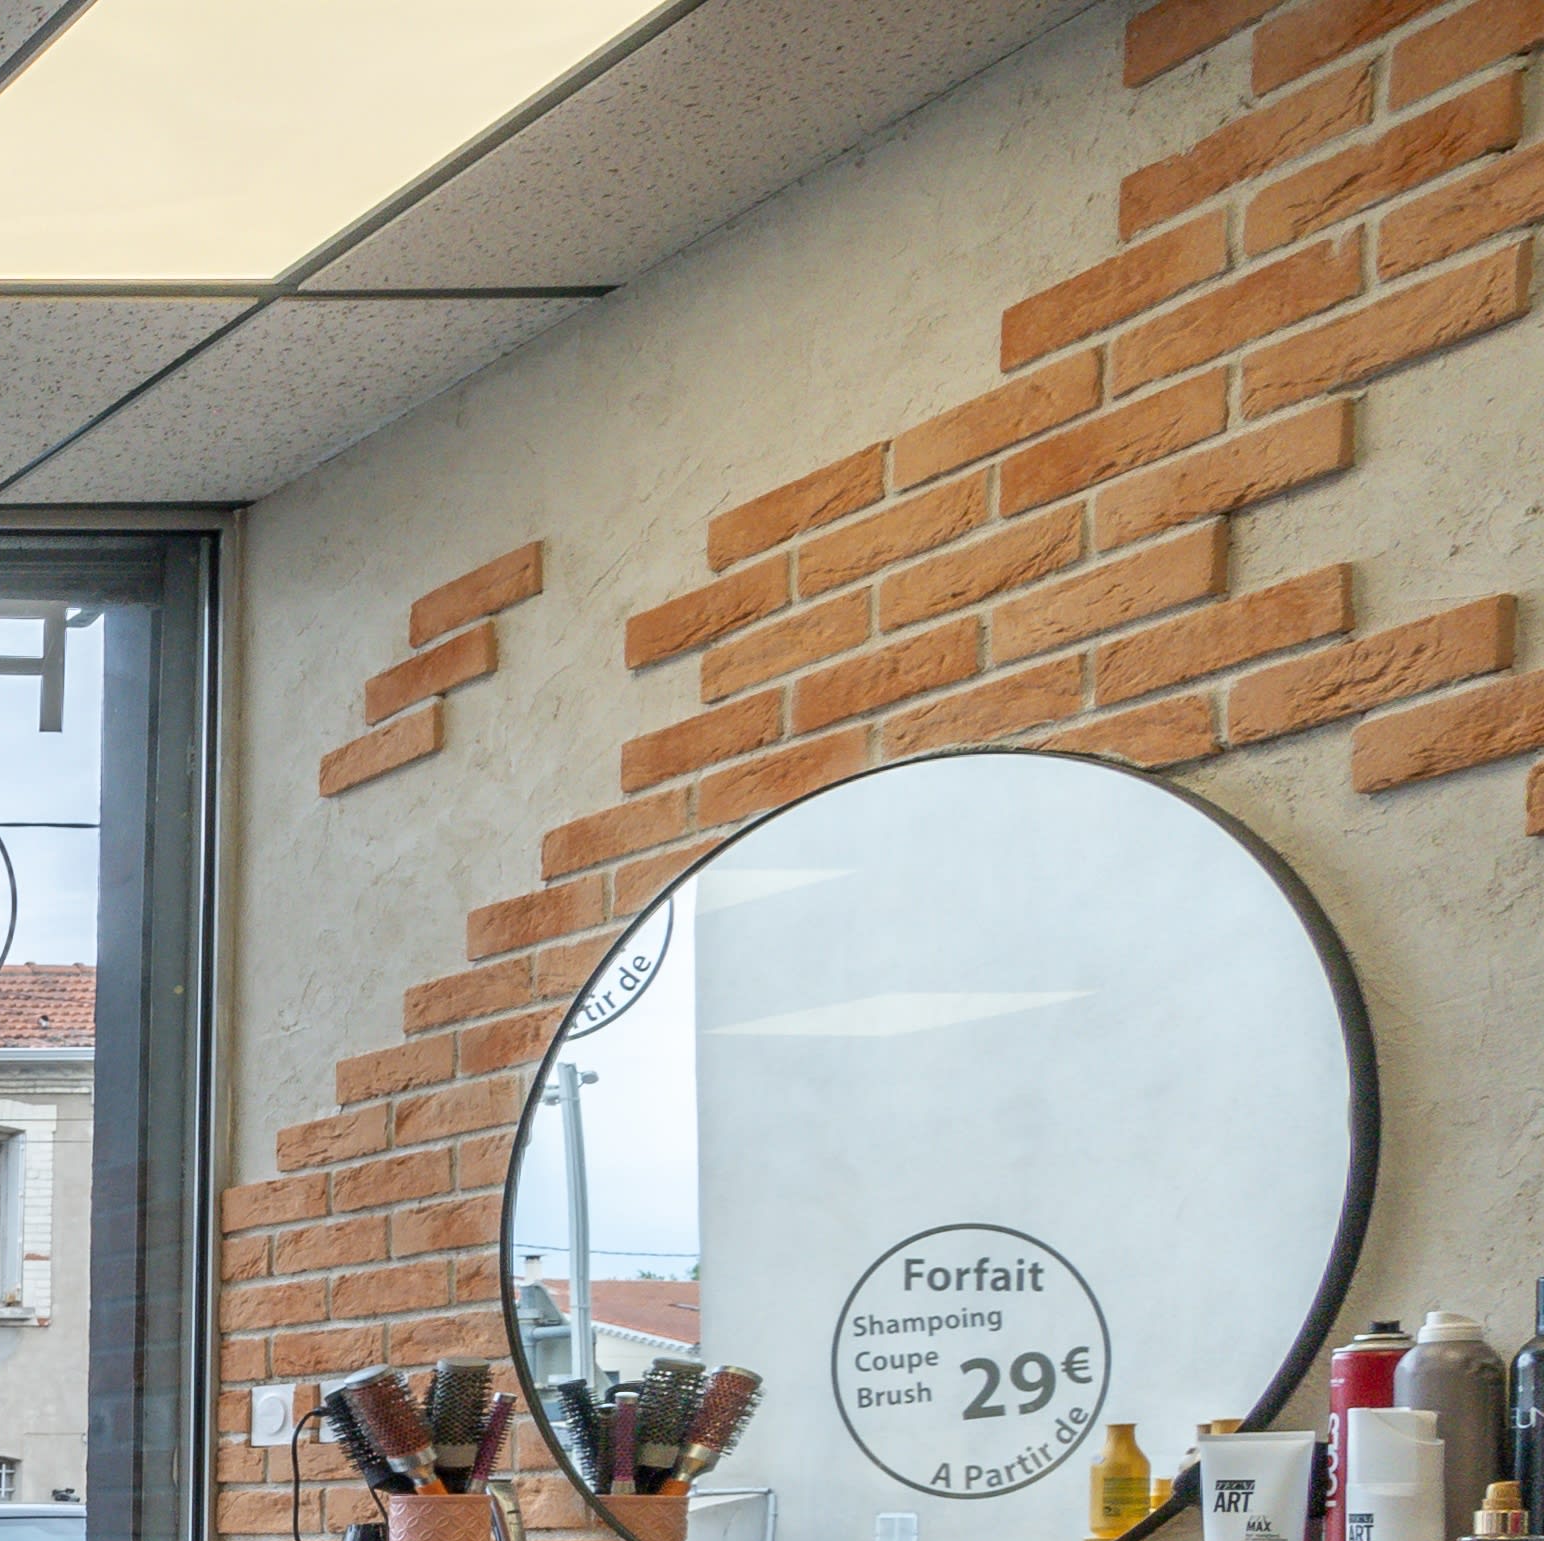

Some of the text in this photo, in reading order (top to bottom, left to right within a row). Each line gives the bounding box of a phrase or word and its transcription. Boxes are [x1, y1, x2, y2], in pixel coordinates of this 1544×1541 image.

[618, 956, 652, 991] de
[901, 1256, 1045, 1294] Forfait
[852, 1306, 1004, 1339] Shampoing
[855, 1347, 941, 1377] Coupe
[856, 1382, 933, 1410] Brush
[958, 1345, 1095, 1421] 29€
[930, 1403, 1090, 1491] A Partir de
[1213, 1492, 1254, 1513] ART
[1246, 1521, 1272, 1532] MAX
